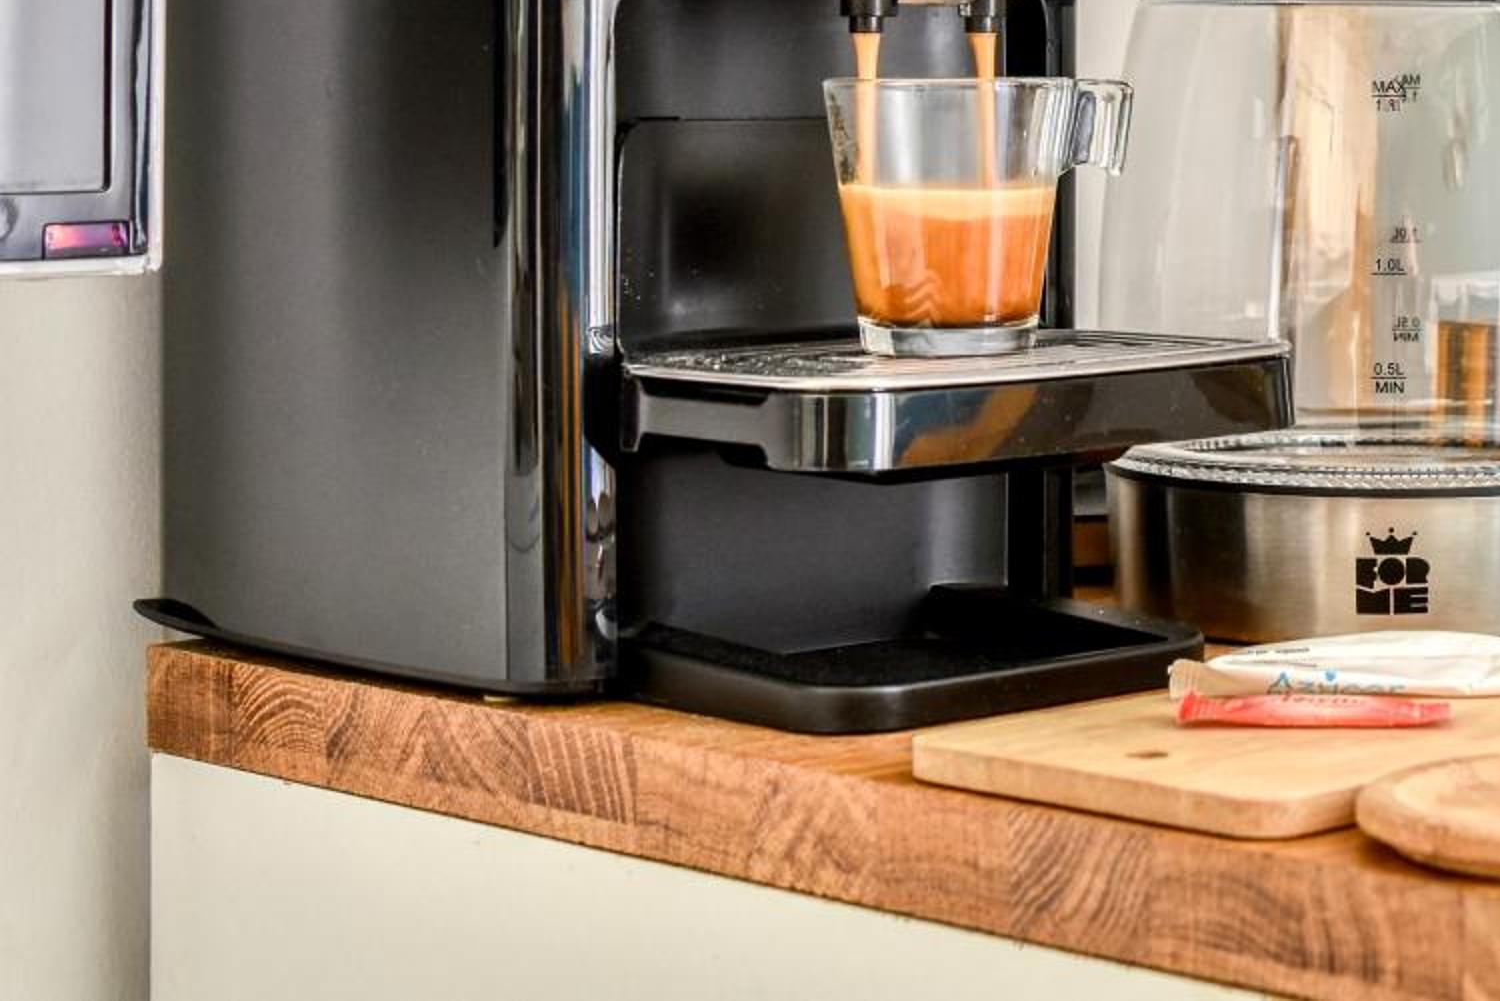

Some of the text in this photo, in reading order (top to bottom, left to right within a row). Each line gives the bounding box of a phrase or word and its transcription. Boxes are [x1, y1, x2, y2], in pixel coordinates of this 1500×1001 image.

[1372, 80, 1406, 94] MAX
[1375, 258, 1405, 272] 1.0L
[1373, 362, 1405, 376] 0.5L
[1375, 381, 1405, 394] MIN
